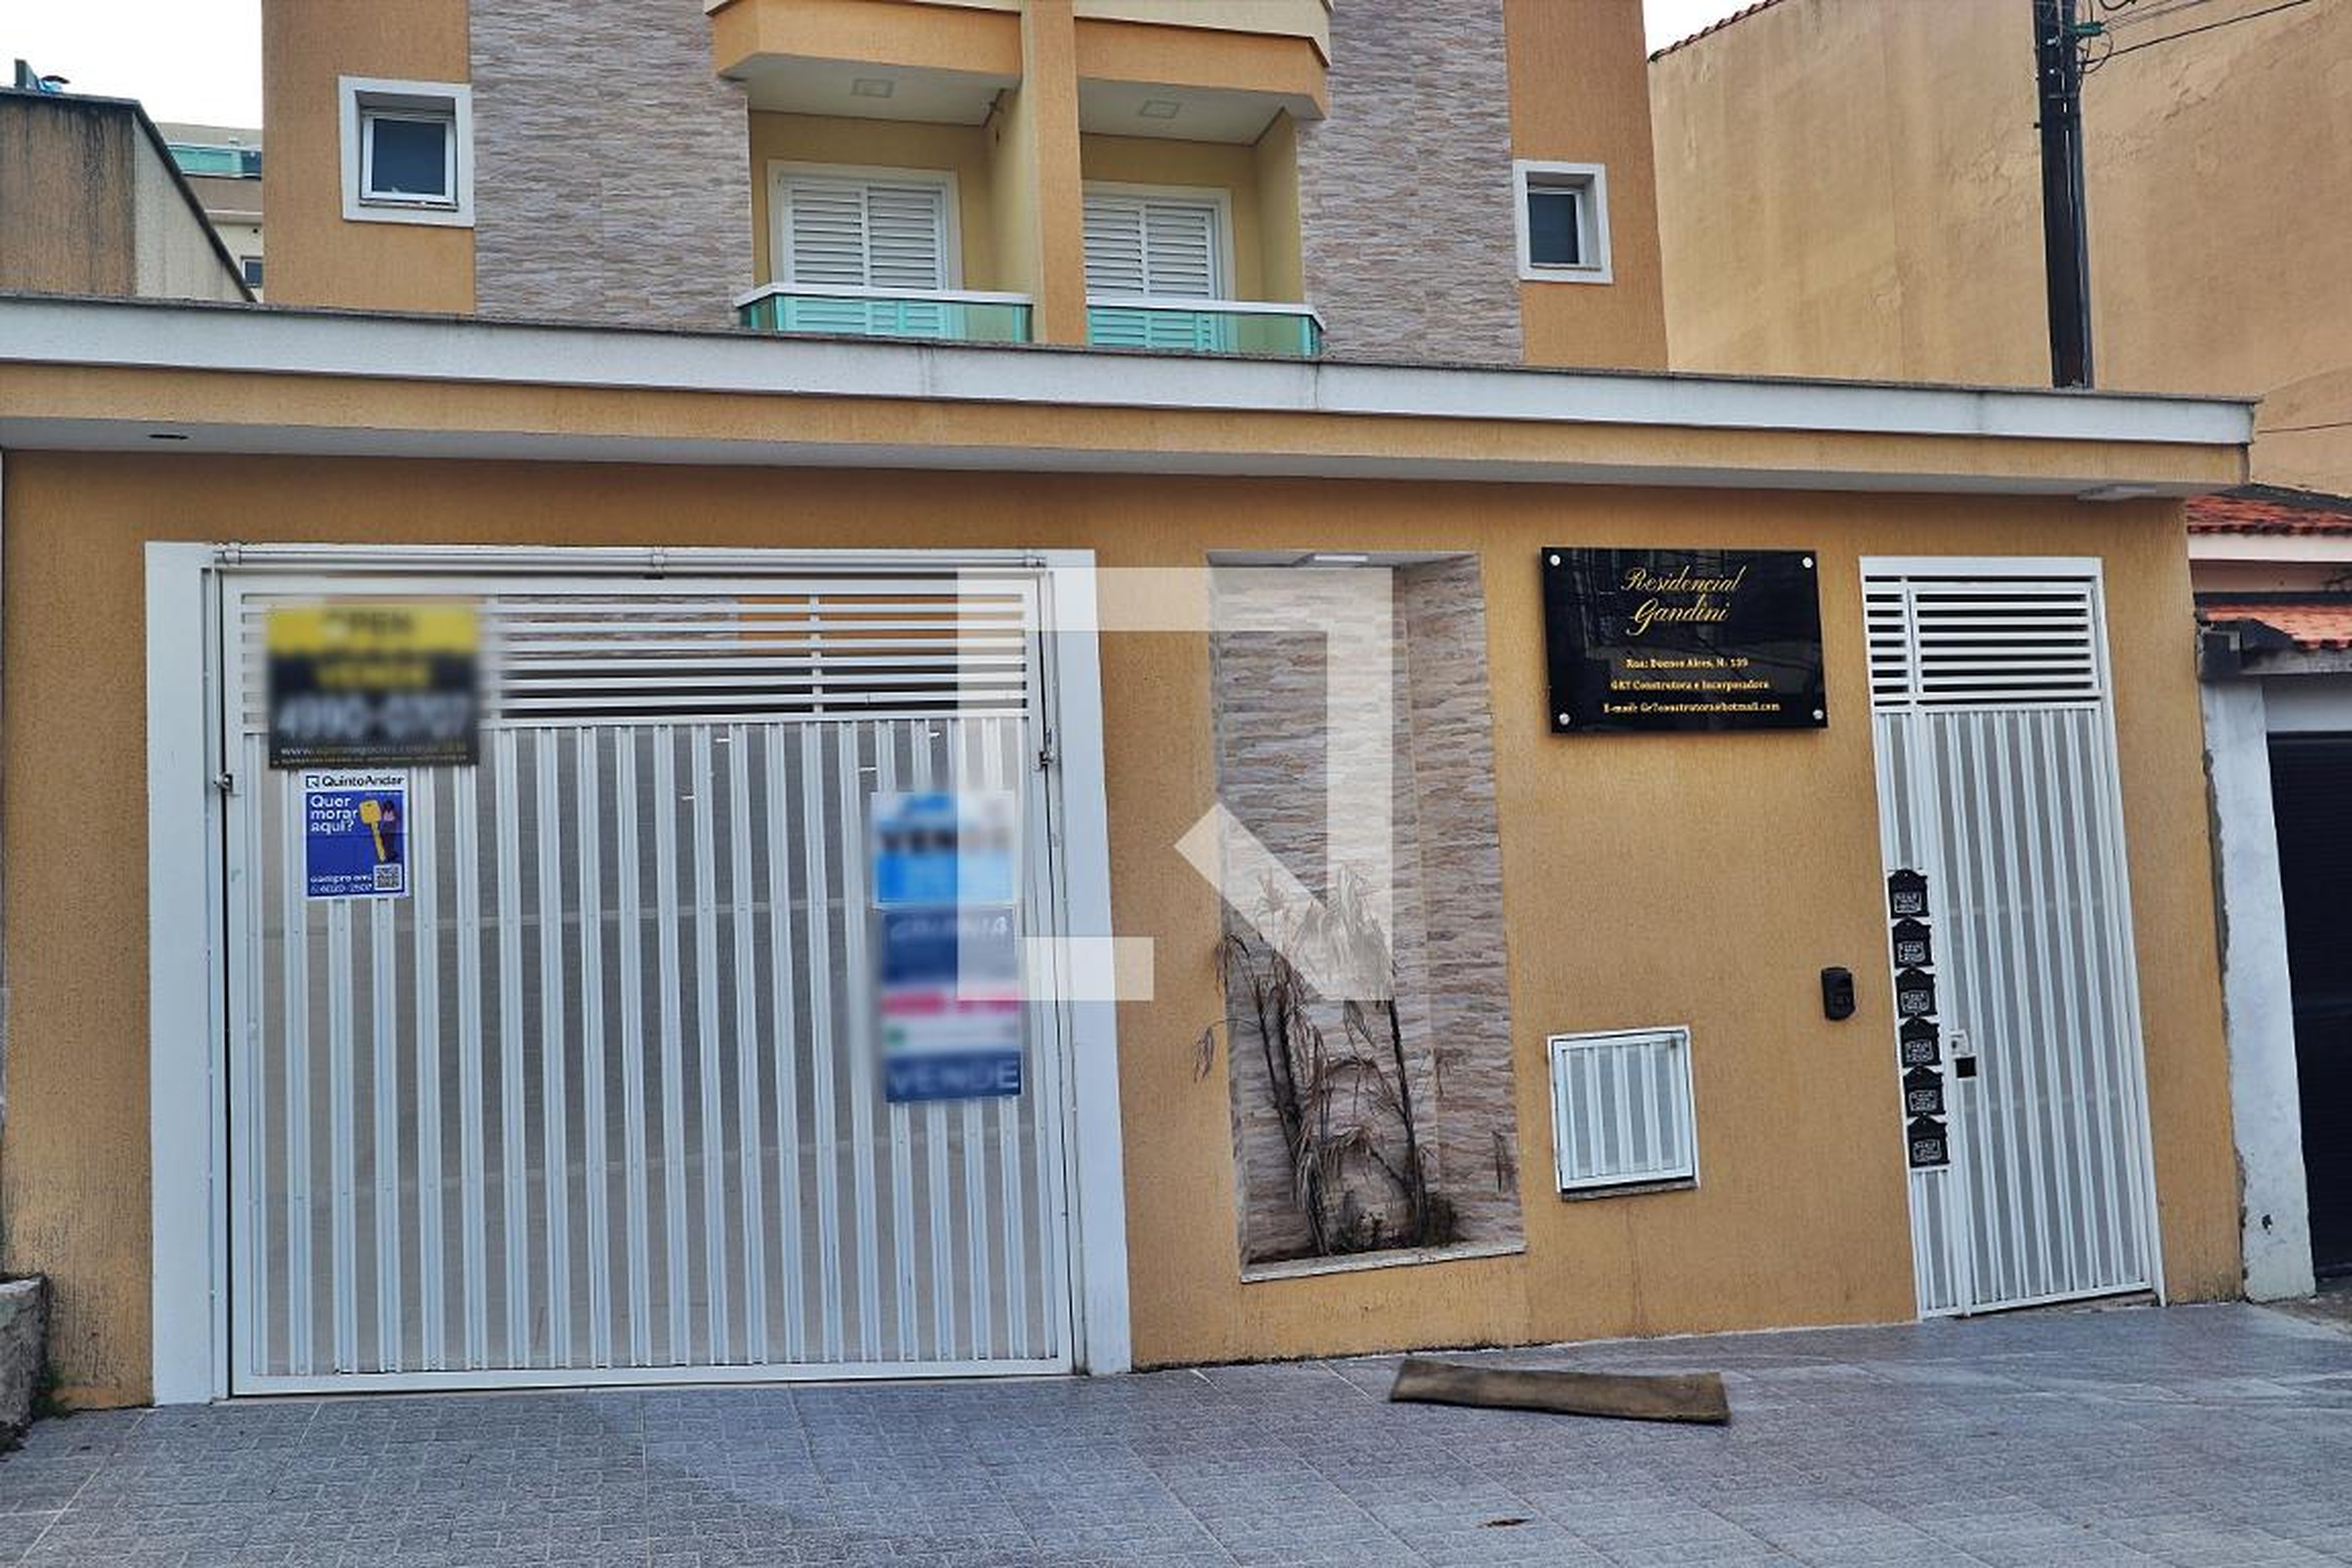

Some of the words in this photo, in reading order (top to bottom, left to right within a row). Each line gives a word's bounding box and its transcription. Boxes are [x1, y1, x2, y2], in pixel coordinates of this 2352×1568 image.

[1621, 565, 1747, 592] Residencial
[1626, 593, 1731, 636] Gandini
[1633, 679, 1692, 690] Construtora
[1702, 679, 1770, 692] Incorporadora
[322, 775, 405, 787] QuintoAndar
[311, 794, 352, 809] Quer
[311, 809, 358, 820] morar
[311, 820, 355, 835] aqui?
